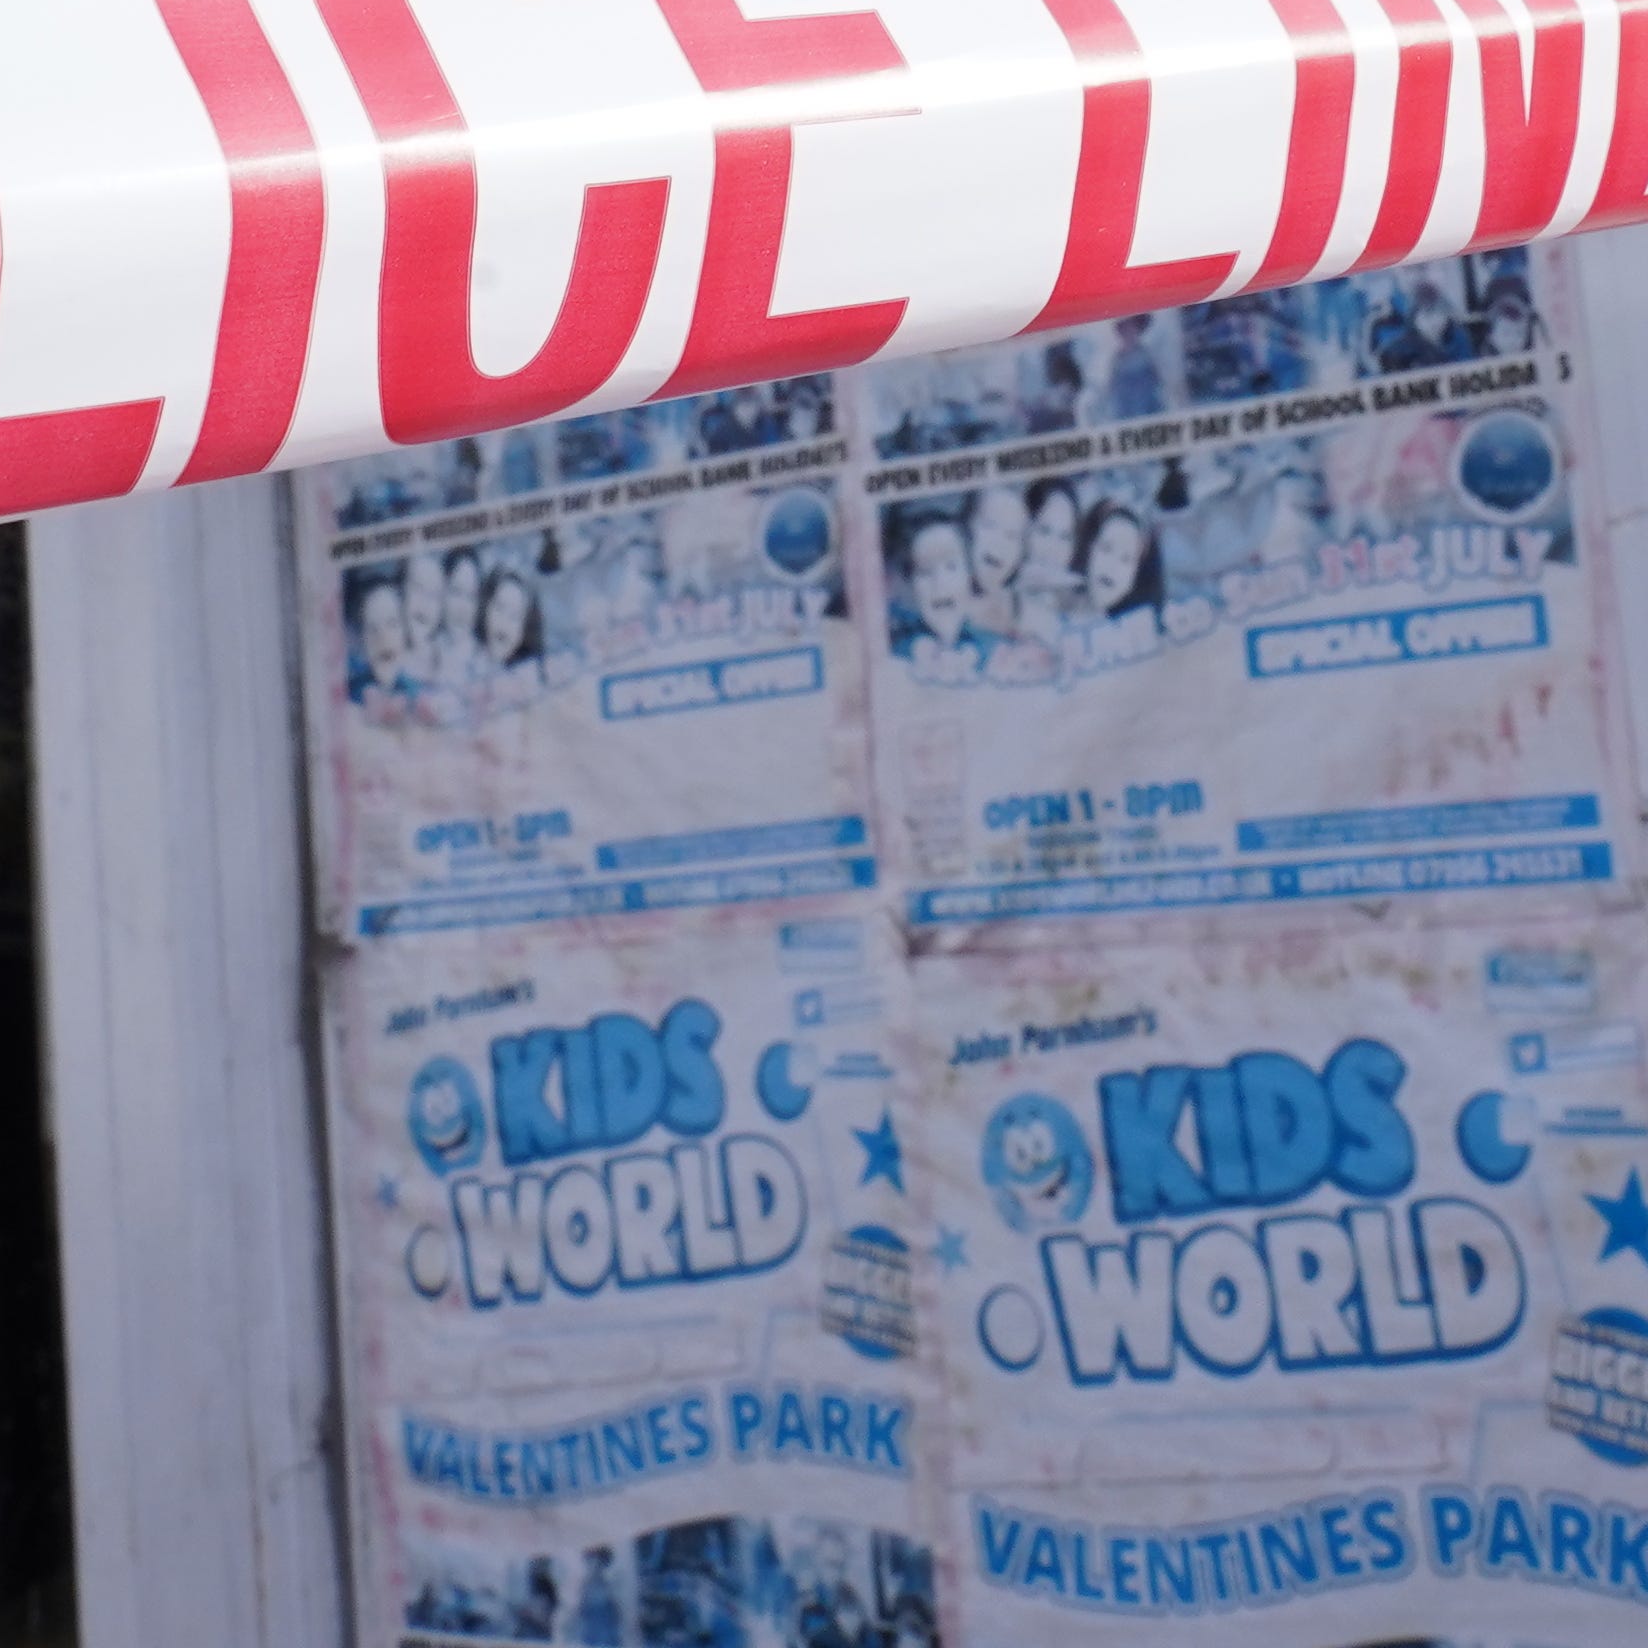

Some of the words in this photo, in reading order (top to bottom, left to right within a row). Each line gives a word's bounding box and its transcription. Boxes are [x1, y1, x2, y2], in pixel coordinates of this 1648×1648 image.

[864, 466, 921, 495] OPEN
[1118, 419, 1184, 452] EVERY
[1190, 411, 1232, 441] DAY
[1239, 405, 1268, 433] OF
[1275, 389, 1365, 428] SCHOOL
[1370, 376, 1442, 412] BANK
[1422, 526, 1555, 588] JULY
[983, 792, 1071, 831] OPEN
[489, 997, 726, 1168] KIDS
[1098, 1037, 1416, 1224] KIDS
[451, 1132, 808, 1311] WORLD
[1040, 1195, 1528, 1388] WORLD
[402, 1396, 712, 1499] VALENTINES
[731, 1391, 905, 1469] PARK
[976, 1497, 1408, 1606] VALENTINES
